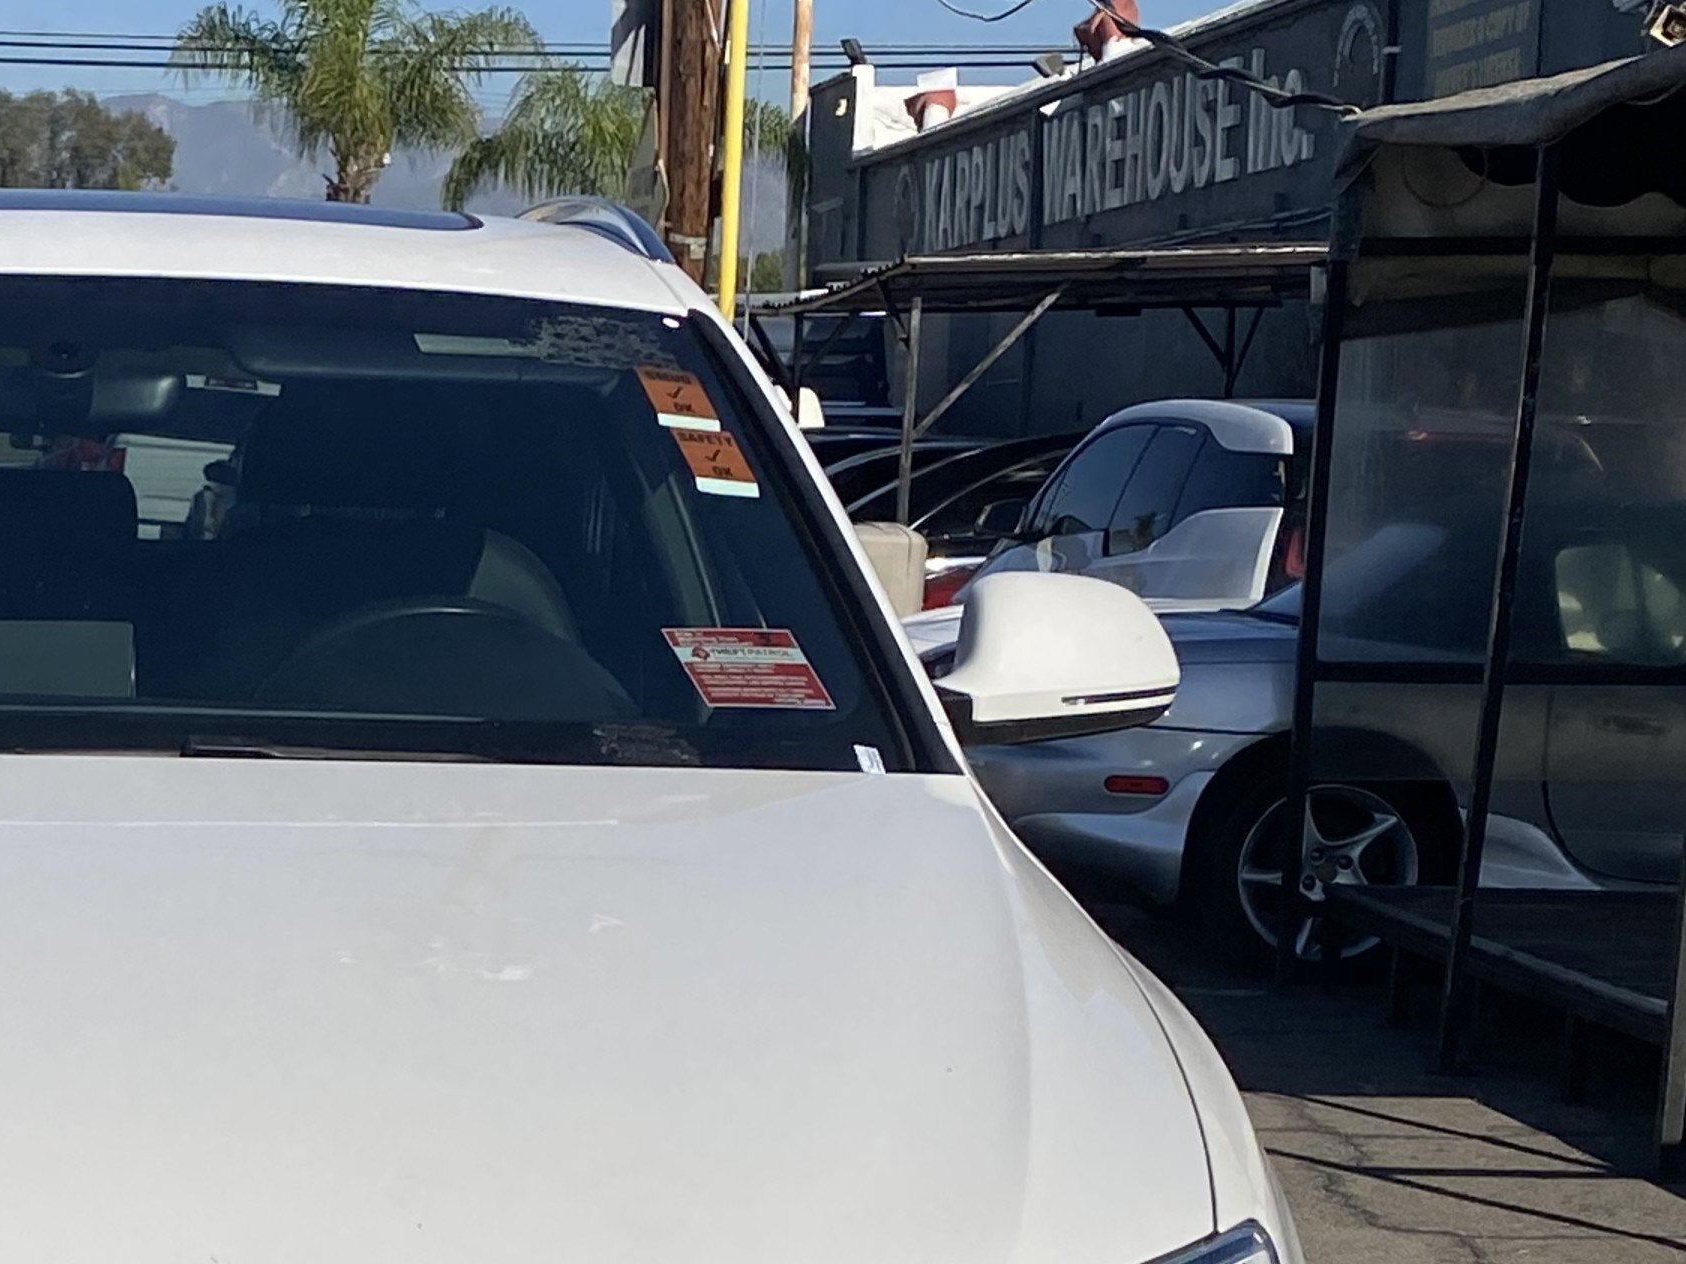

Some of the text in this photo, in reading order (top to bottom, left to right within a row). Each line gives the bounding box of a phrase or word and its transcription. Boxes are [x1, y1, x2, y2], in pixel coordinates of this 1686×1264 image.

[924, 48, 1314, 252] KARPLUS WAREHOUSE Inc.
[677, 432, 733, 446] SAFETY
[712, 465, 733, 477] OK
